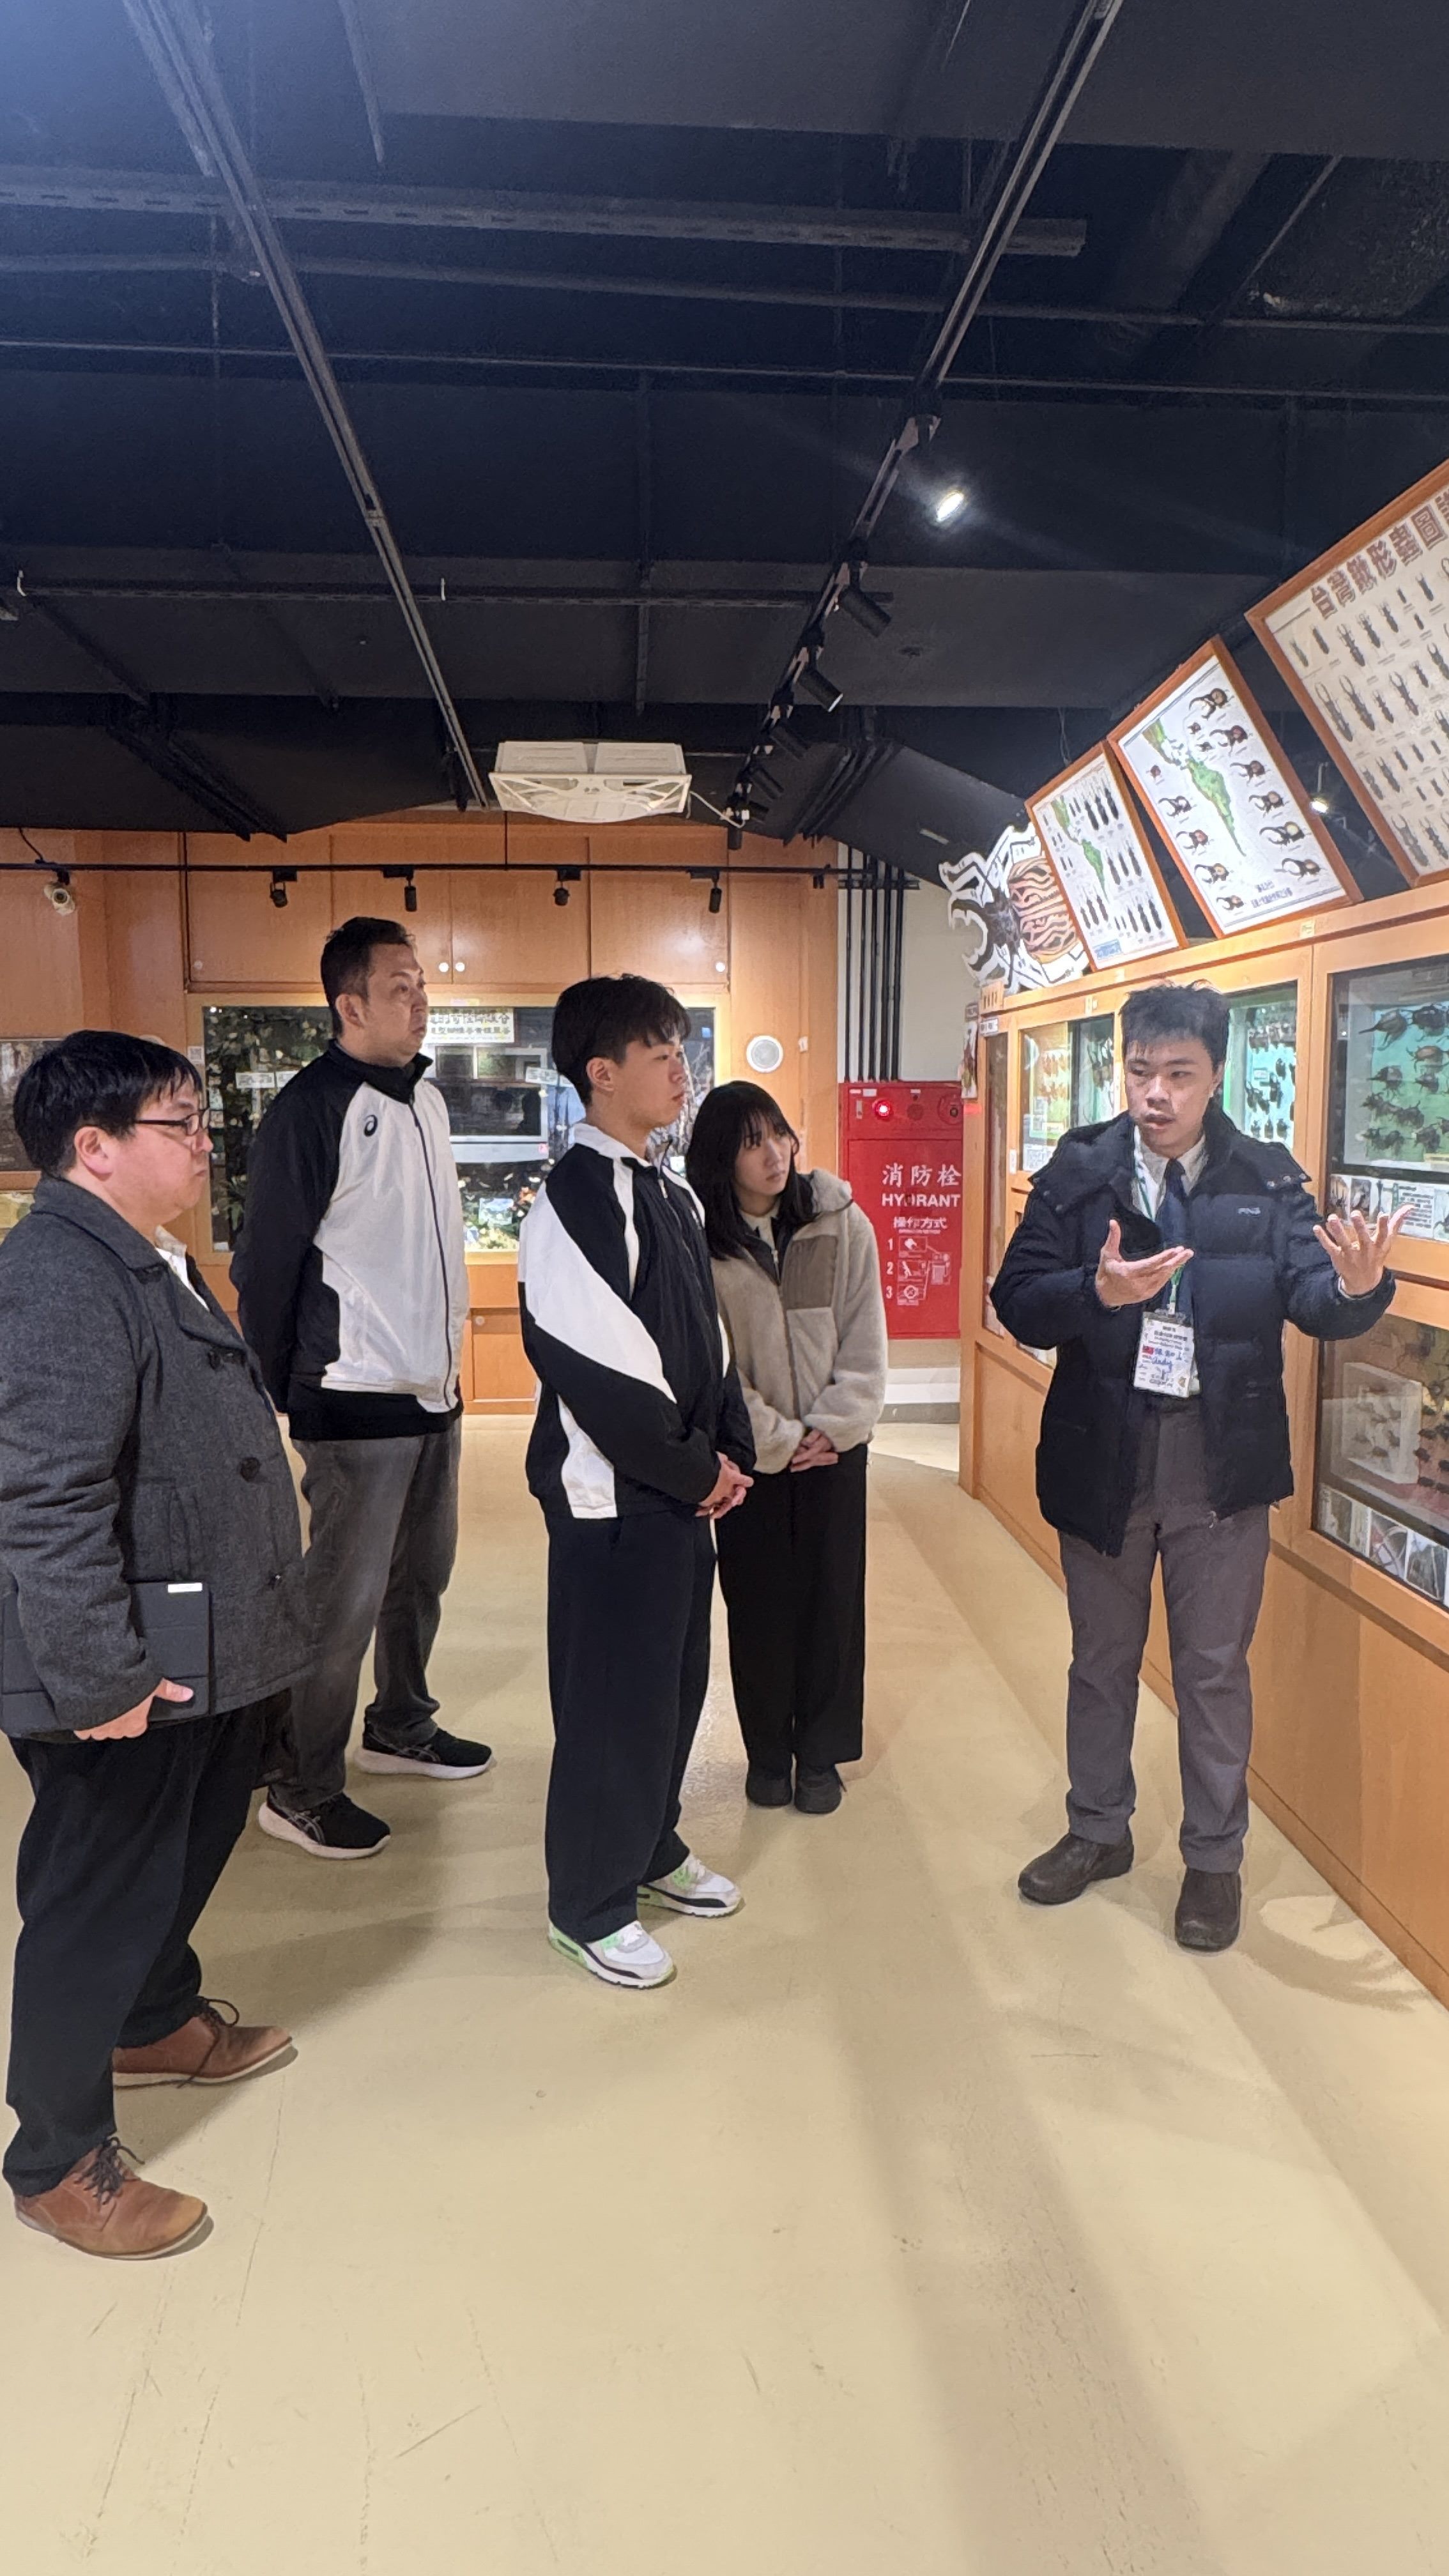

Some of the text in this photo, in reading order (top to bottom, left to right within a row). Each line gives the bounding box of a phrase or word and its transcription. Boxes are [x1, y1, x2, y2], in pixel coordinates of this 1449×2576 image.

[882, 1163, 962, 1187] 消防栓
[893, 1216, 947, 1229] 操作方式
[888, 1238, 893, 1250] 1
[887, 1261, 893, 1275] 2
[886, 1285, 893, 1300] 3
